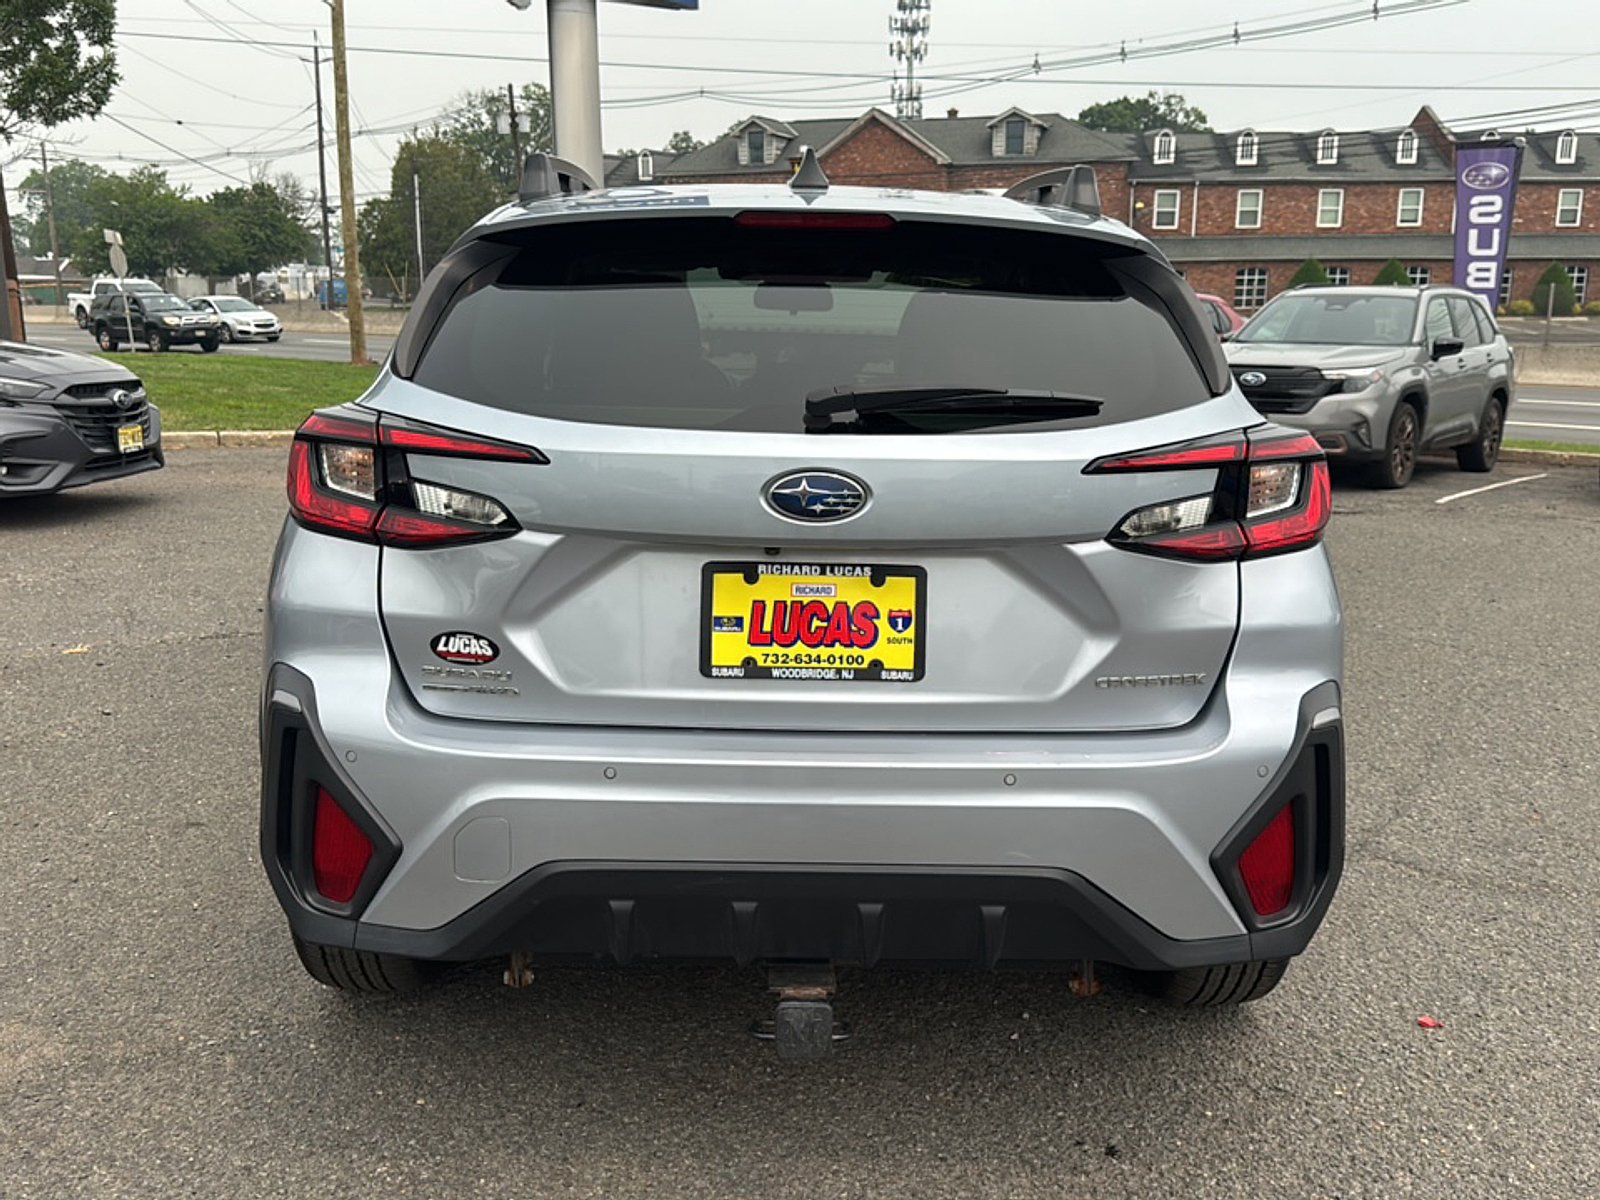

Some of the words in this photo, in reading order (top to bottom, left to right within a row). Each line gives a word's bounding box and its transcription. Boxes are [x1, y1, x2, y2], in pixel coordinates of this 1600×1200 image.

[757, 564, 821, 576] RICHARD
[826, 565, 872, 576] LUCAS
[795, 586, 833, 596] RICHARD
[747, 600, 880, 650] LUCAS
[896, 617, 904, 631] 1
[436, 636, 494, 657] LUCAS
[887, 637, 913, 645] SOUTH
[761, 653, 865, 665] 732-634-0100
[712, 667, 745, 677] SUBARU
[841, 669, 855, 680] NJ
[881, 670, 914, 680] SUBARU
